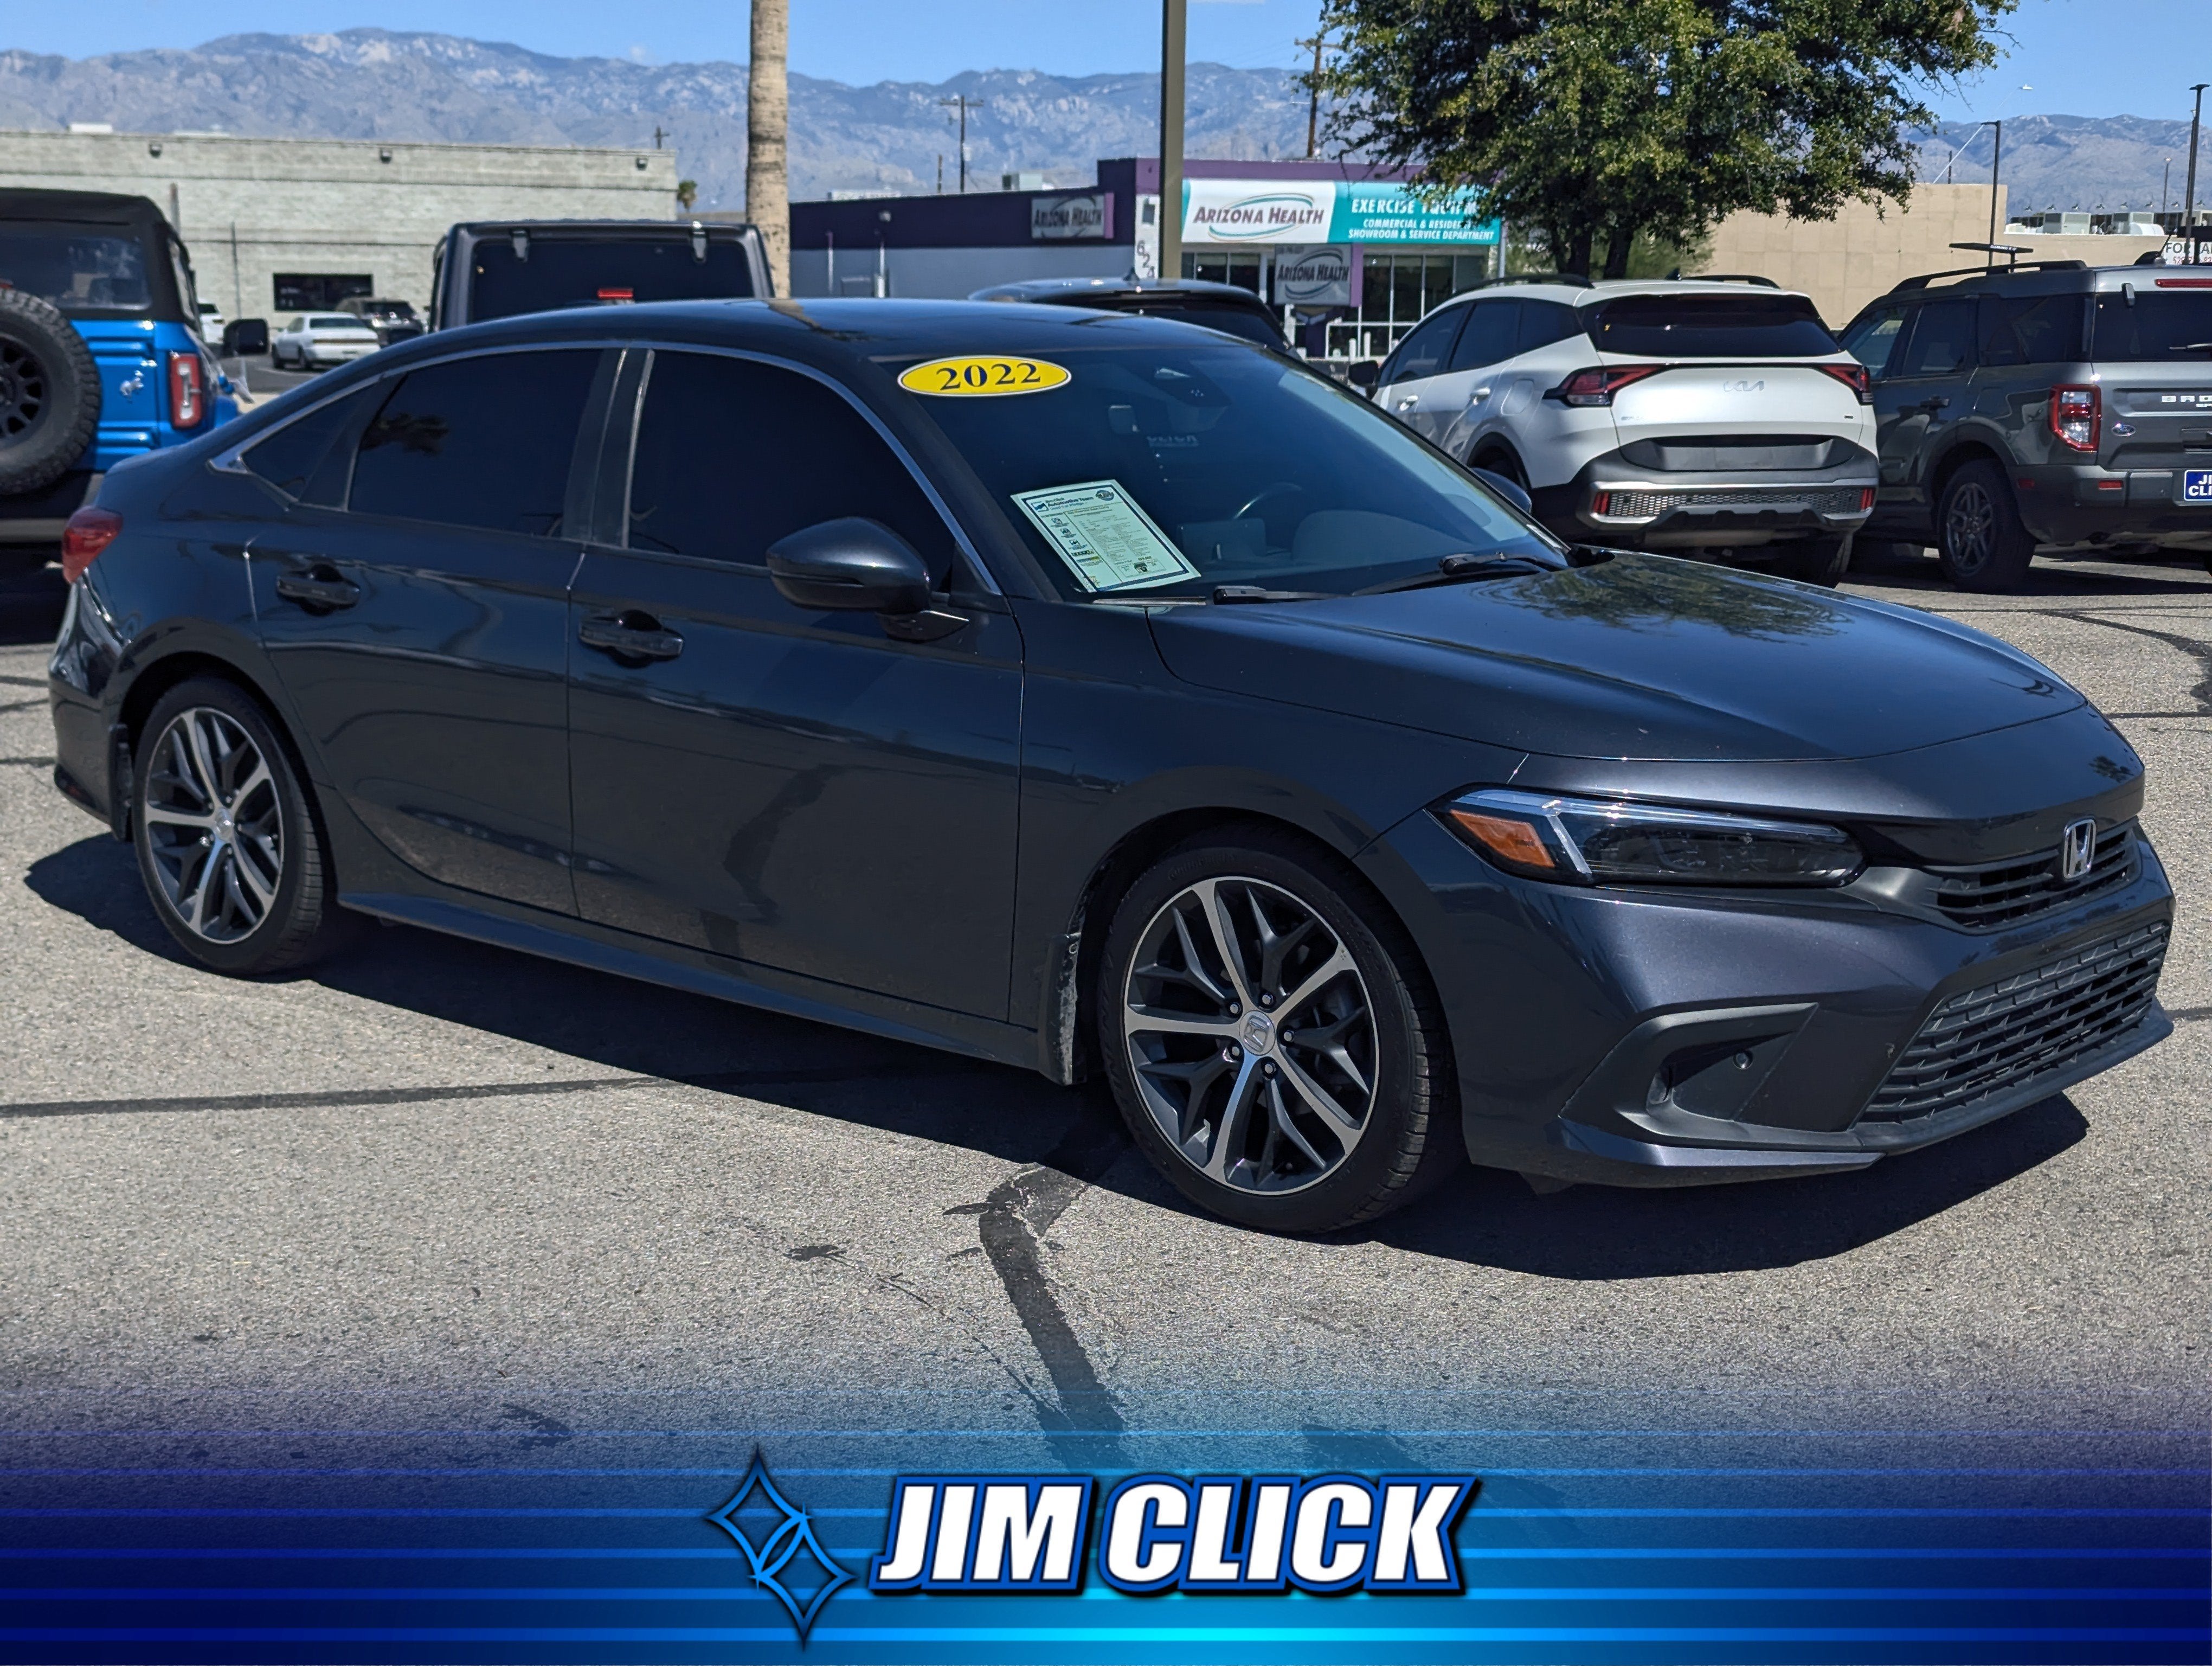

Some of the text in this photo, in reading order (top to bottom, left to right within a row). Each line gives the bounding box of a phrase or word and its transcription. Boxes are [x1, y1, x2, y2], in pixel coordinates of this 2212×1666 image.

[1351, 198, 1414, 214] EXERCISE
[1194, 207, 1324, 224] ARIZONA HEALTH
[1363, 219, 1417, 228] COMMERCIAL
[1420, 220, 1426, 228] &
[1348, 229, 1494, 240] SHOWROOM & SERVICE DEPARTMENT
[1277, 264, 1349, 281] ARIZONA HEALTH
[936, 363, 1040, 390] 2022
